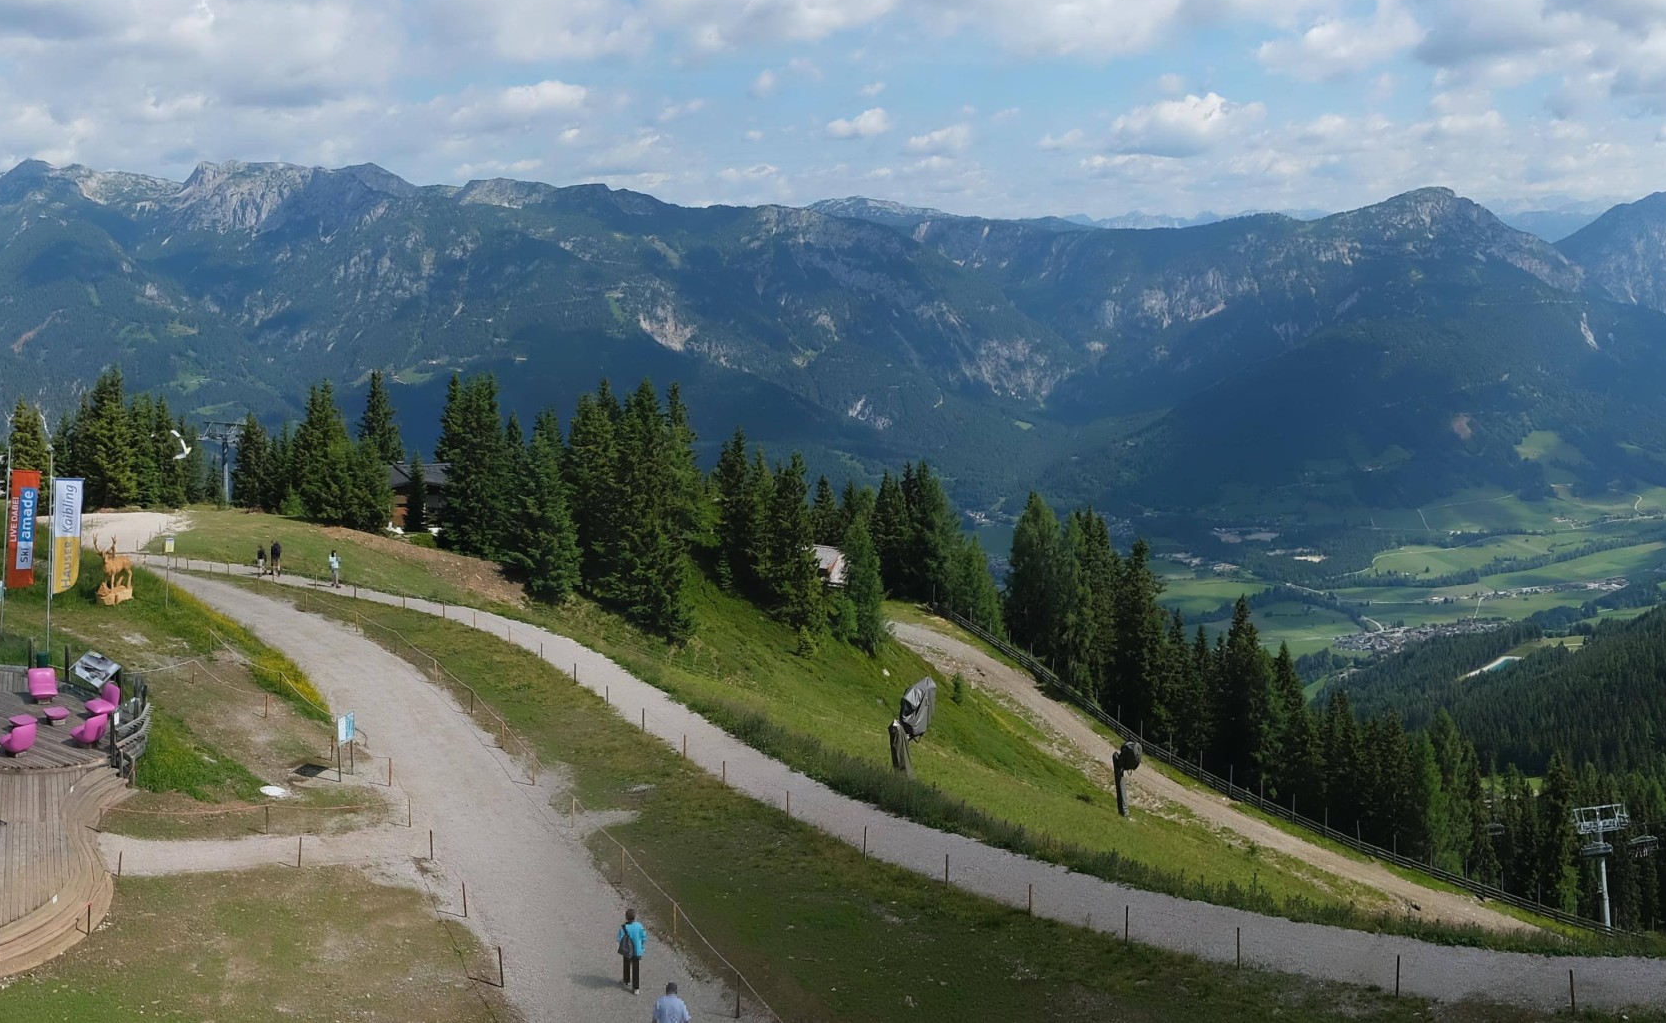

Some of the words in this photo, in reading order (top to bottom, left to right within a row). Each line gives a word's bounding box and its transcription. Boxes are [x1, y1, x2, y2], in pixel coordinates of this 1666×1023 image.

[12, 496, 20, 523] DABEI
[62, 484, 78, 534] Kaibling
[9, 524, 18, 542] LIVE
[20, 548, 29, 563] Ski
[61, 540, 72, 588] HAUSER
